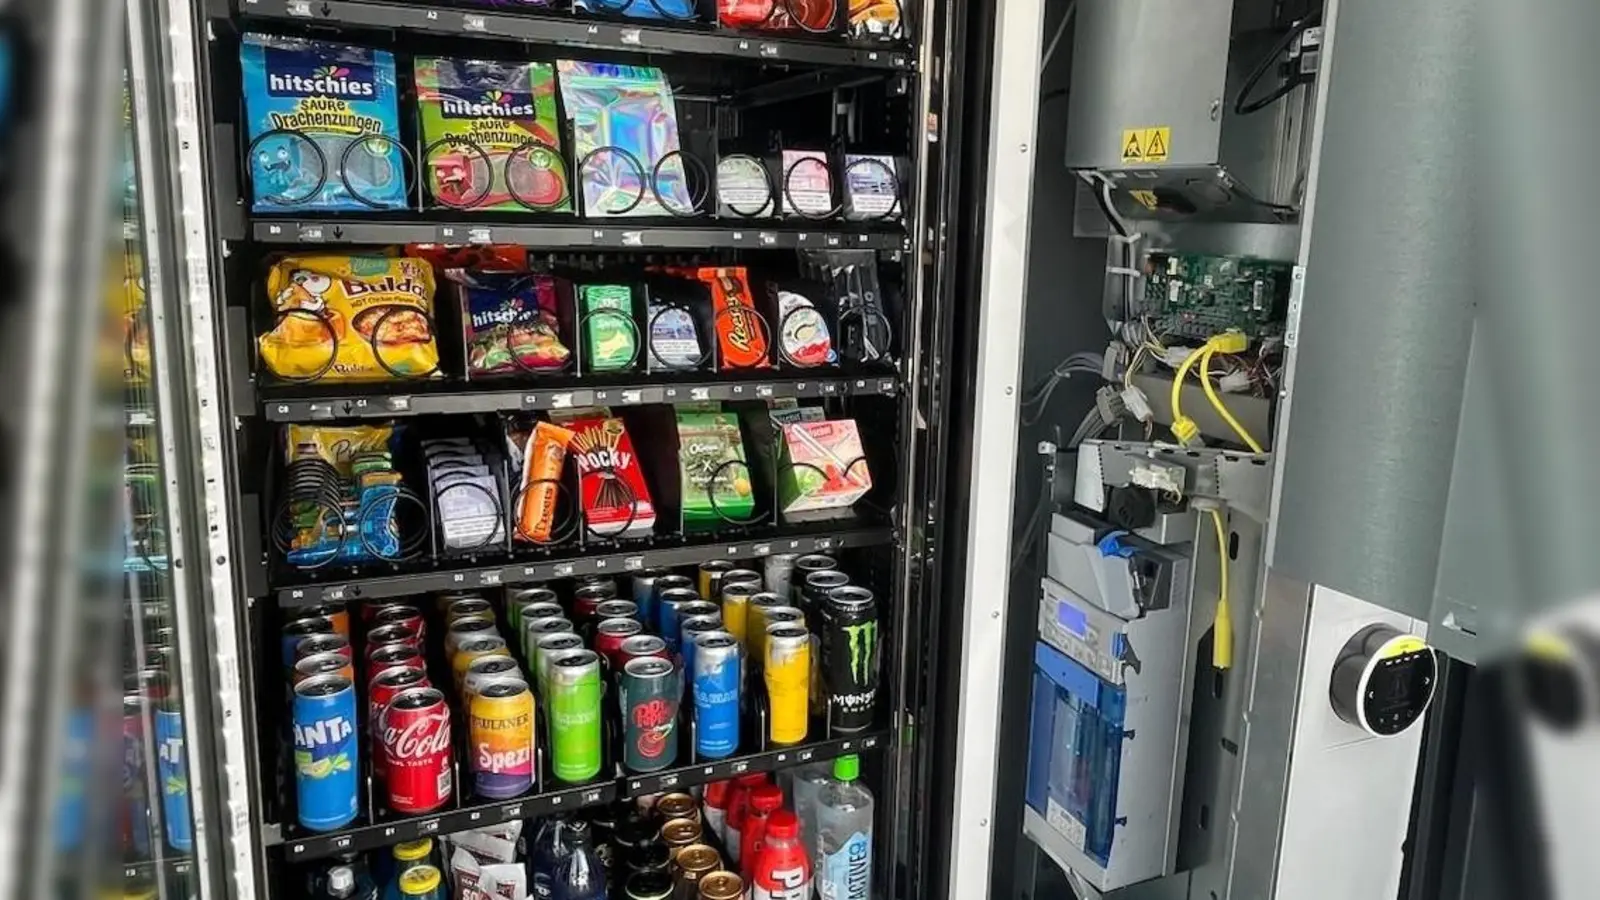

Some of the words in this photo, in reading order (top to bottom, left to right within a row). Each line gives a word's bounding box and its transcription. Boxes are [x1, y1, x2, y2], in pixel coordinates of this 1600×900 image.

[269, 74, 374, 95] hitschies
[442, 101, 534, 116] hitschies
[271, 109, 382, 133] Drachenzungen
[479, 742, 530, 773] Spezi
